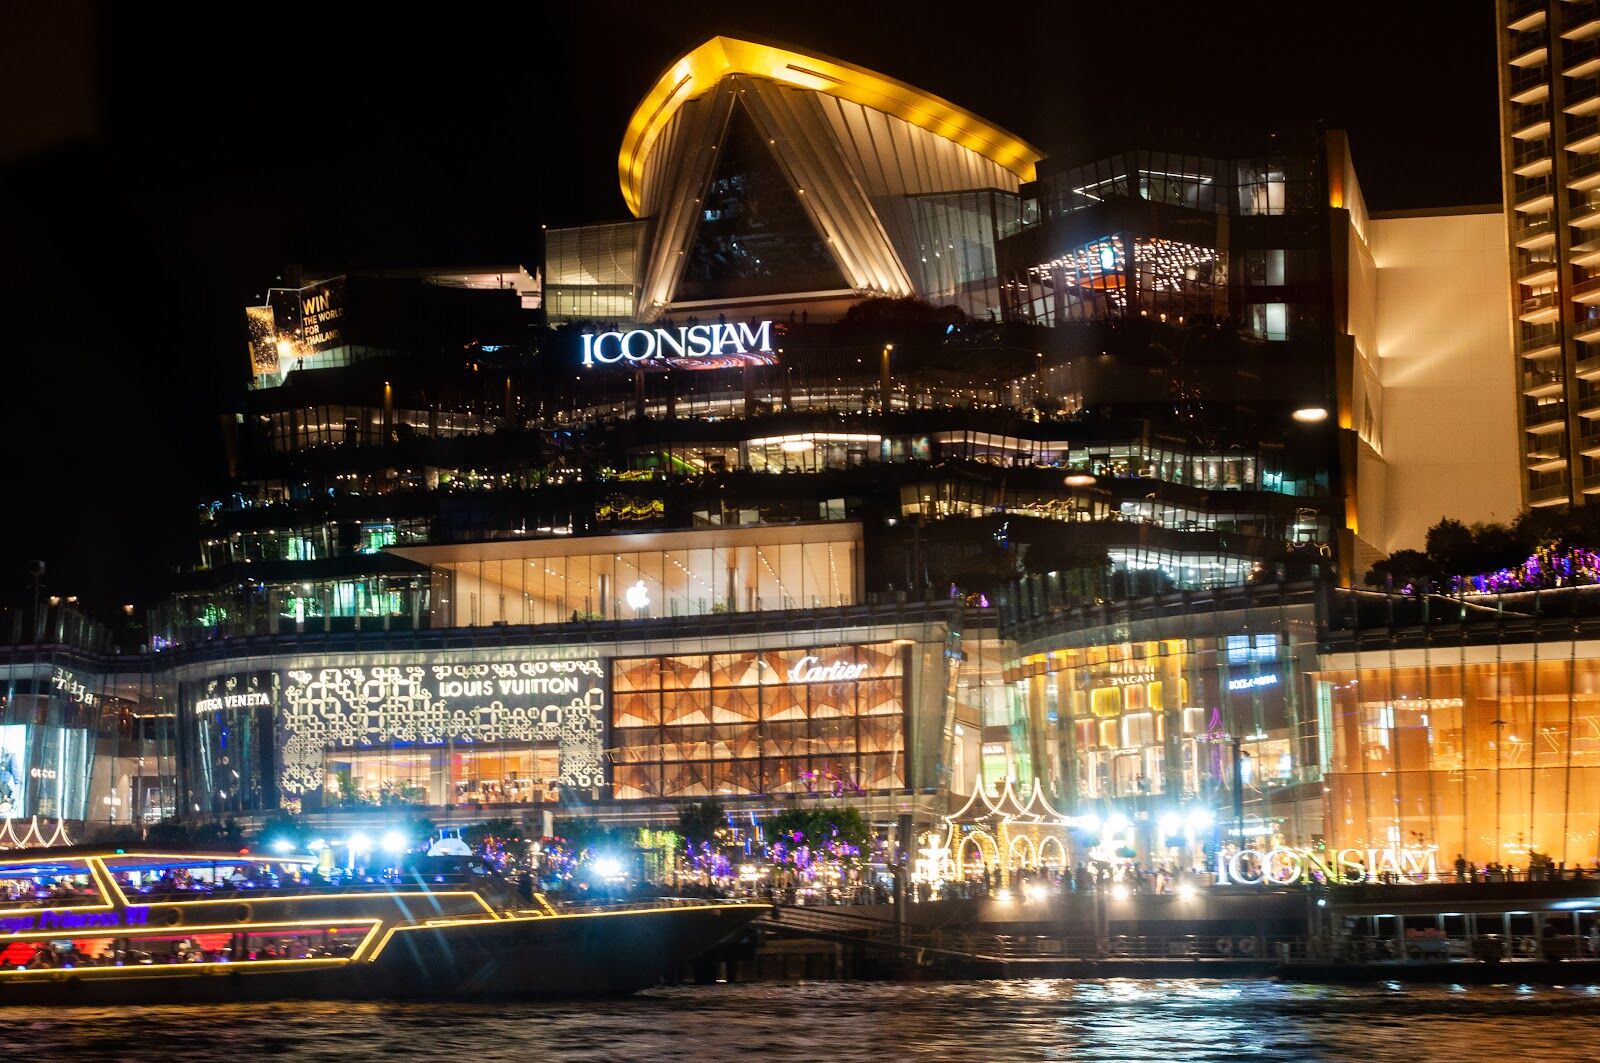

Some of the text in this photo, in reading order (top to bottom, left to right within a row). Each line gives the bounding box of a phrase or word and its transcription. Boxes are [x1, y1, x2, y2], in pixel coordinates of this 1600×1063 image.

[303, 292, 329, 315] WIN
[303, 308, 344, 326] THE WORLD
[304, 324, 319, 336] FOR
[305, 330, 340, 345] THAILAND
[581, 320, 773, 365] ICONSIAM
[787, 656, 868, 683] Cartier
[439, 676, 579, 698] LOUIS VUITTON
[224, 692, 270, 708] VENETA
[1215, 847, 1441, 886] ICONSIAM
